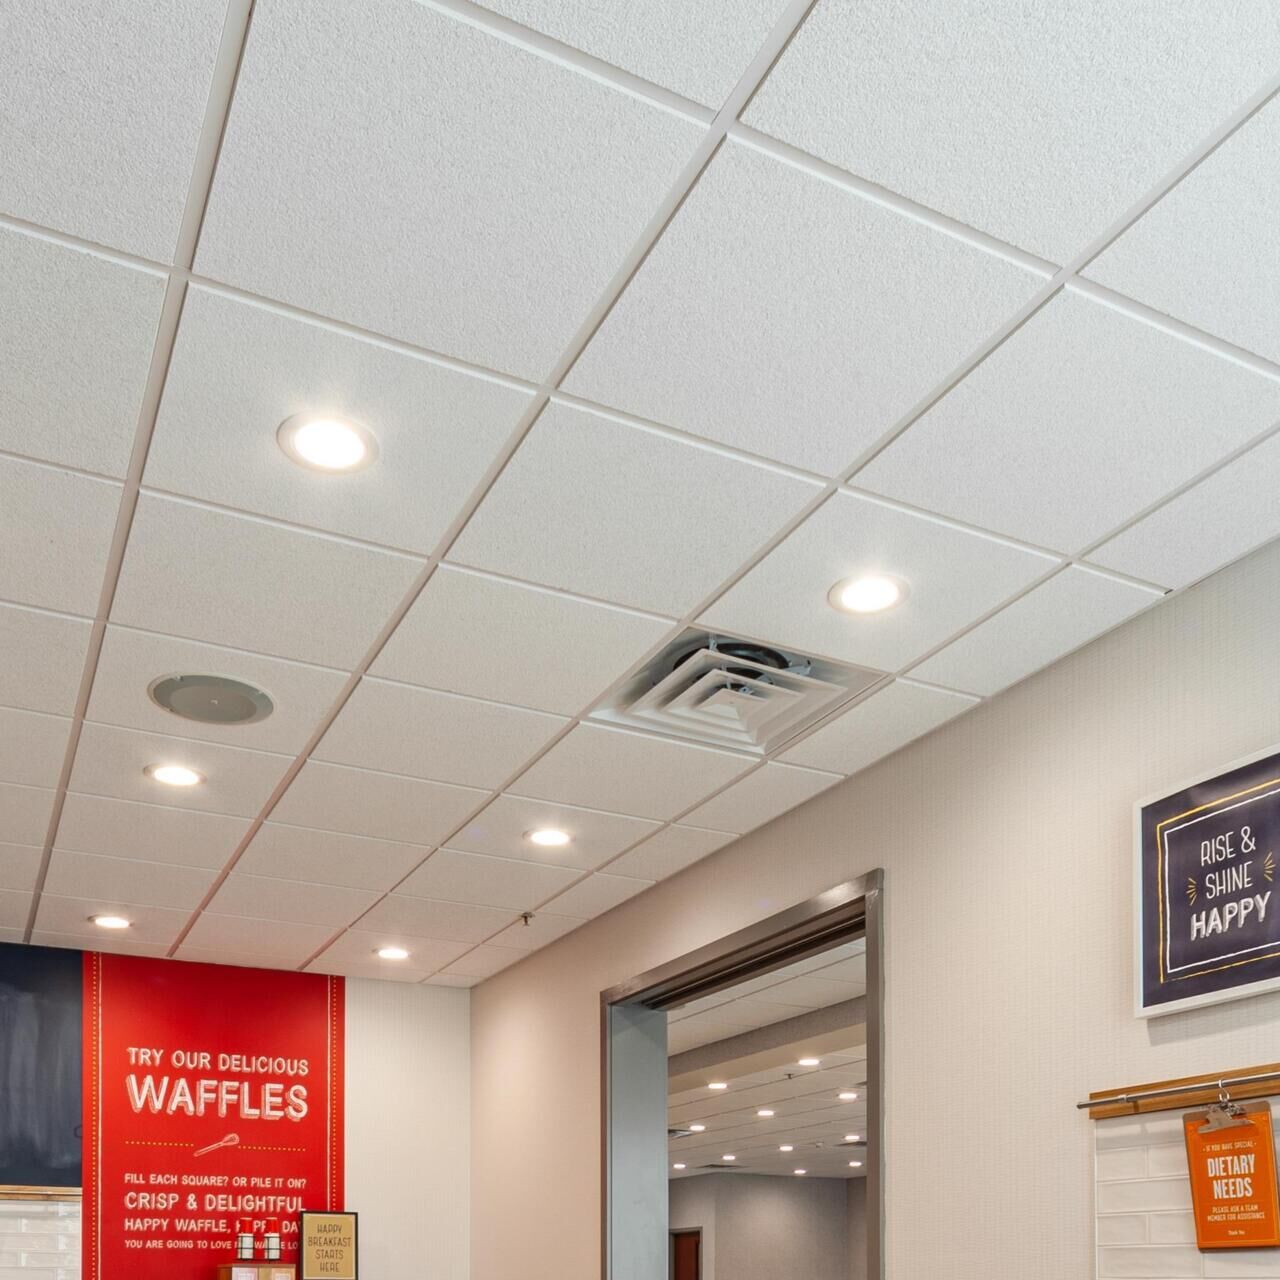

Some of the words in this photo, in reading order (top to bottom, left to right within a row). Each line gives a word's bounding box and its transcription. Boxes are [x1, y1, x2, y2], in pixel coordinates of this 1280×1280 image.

[1200, 831, 1235, 867] RISE
[1240, 825, 1256, 853] &
[1205, 860, 1254, 900] SHINE
[1190, 890, 1271, 941] HAPPY
[127, 1047, 164, 1067] TRY
[171, 1050, 211, 1070] OUR
[218, 1053, 309, 1077] DELICIOUS
[125, 1073, 309, 1122] WAFFLES
[1207, 1153, 1255, 1177] DIETARY
[124, 1173, 146, 1184] FILL
[149, 1173, 178, 1184] EACH
[181, 1175, 229, 1186] SQUARE?
[232, 1176, 247, 1187] OR
[250, 1177, 272, 1188] PILE
[275, 1178, 283, 1188] IT
[287, 1178, 307, 1189] ON?
[1213, 1177, 1253, 1200] NEEDS
[124, 1191, 179, 1211] CRISP
[187, 1193, 198, 1209] &
[205, 1194, 307, 1213] DELIGHTFUL
[124, 1218, 169, 1232] HAPPY
[175, 1219, 231, 1234] WAFFLE,
[282, 1221, 300, 1233] DA
[317, 1223, 342, 1234] HAPPY
[125, 1240, 143, 1249] YOU
[146, 1240, 163, 1249] ARE
[166, 1240, 193, 1249] GOING
[197, 1241, 207, 1249] TO
[211, 1241, 232, 1250] LOVE
[288, 1242, 299, 1250] LO
[307, 1236, 352, 1248] BREAKFAST
[315, 1250, 344, 1260] STARTS
[320, 1262, 340, 1273] HERE
